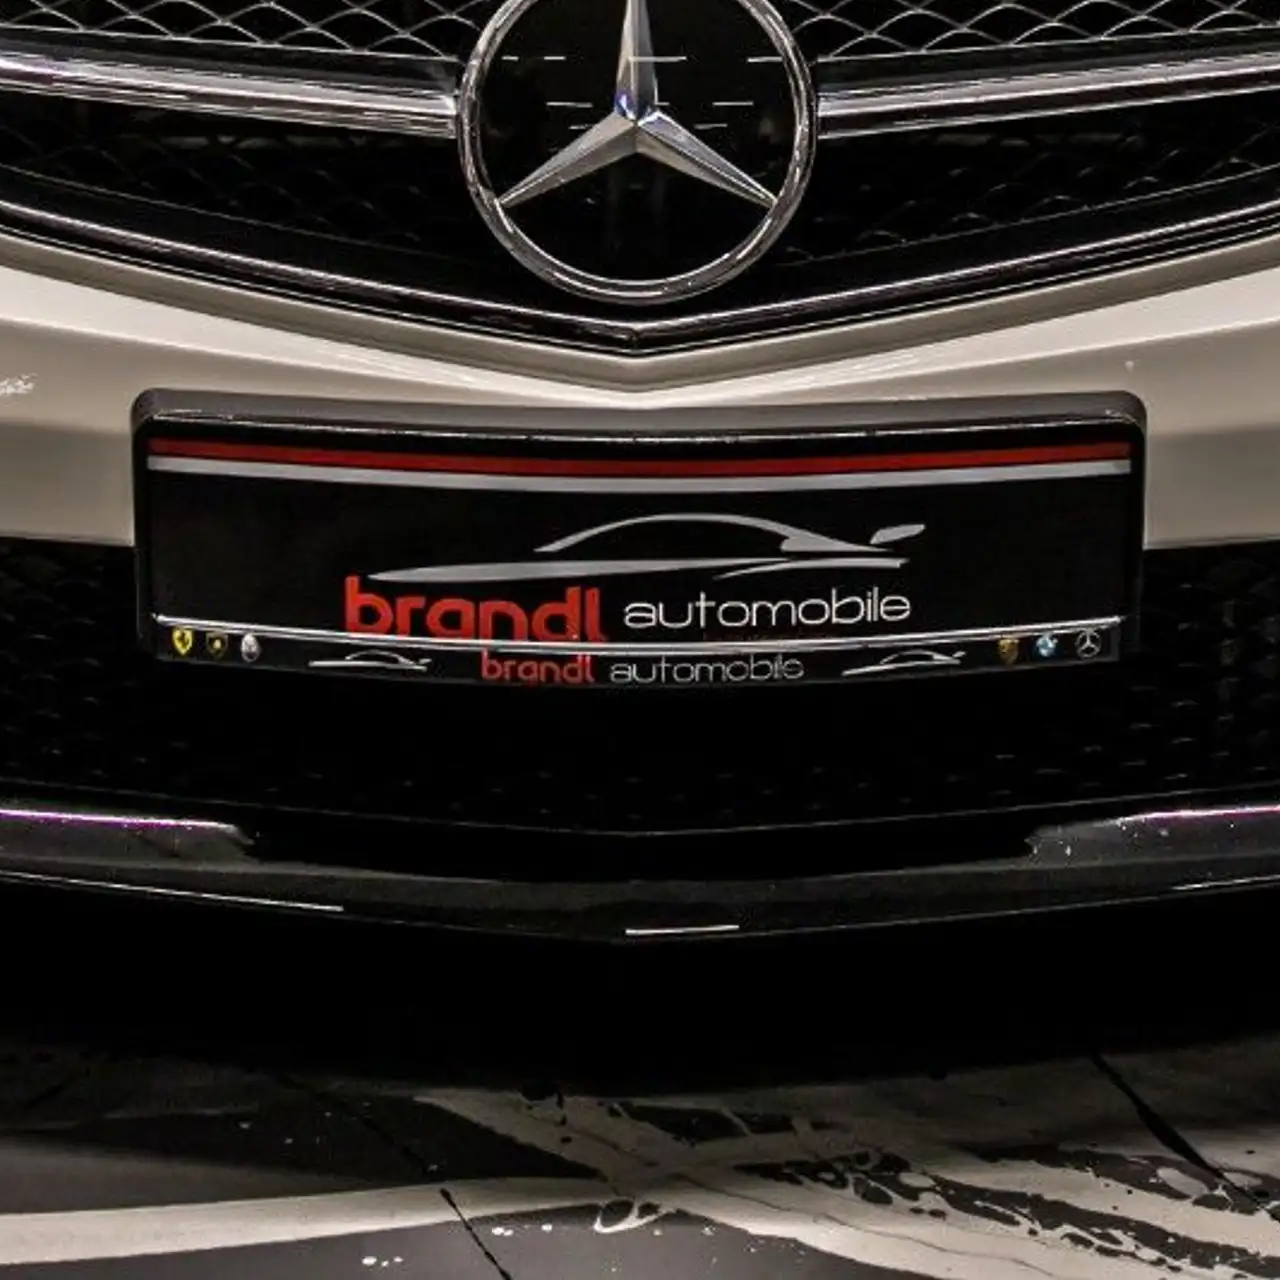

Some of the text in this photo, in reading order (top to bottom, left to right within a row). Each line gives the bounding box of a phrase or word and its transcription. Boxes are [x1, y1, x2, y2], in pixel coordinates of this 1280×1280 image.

[344, 575, 911, 642] brandl automobile
[480, 648, 805, 684] brandl automobile
